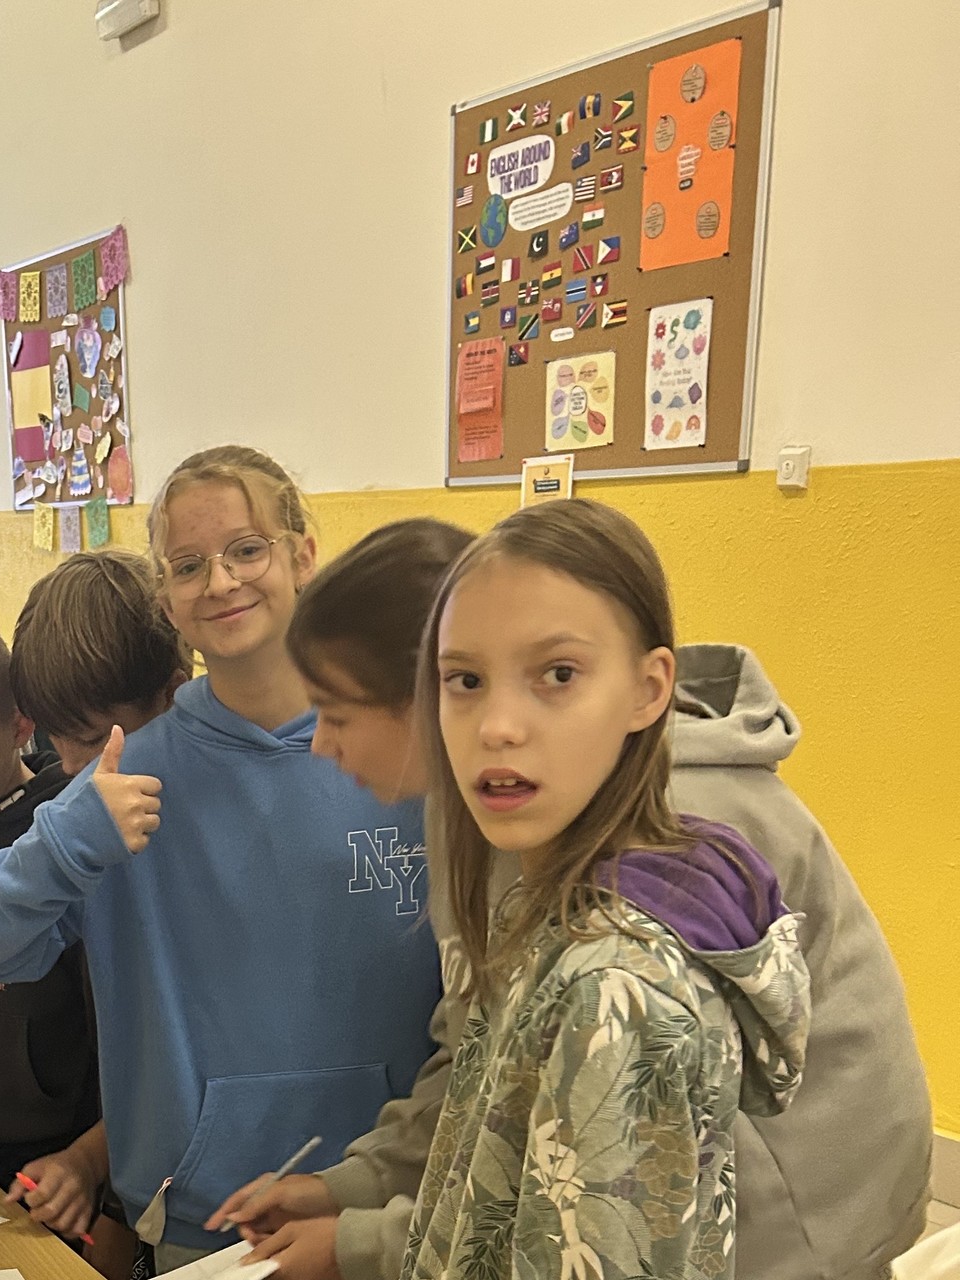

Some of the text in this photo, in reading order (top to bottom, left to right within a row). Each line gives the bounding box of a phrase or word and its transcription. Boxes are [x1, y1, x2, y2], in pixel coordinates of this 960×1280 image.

[490, 140, 551, 178] ENGLISH AROUND
[500, 165, 539, 194] THE WORLD
